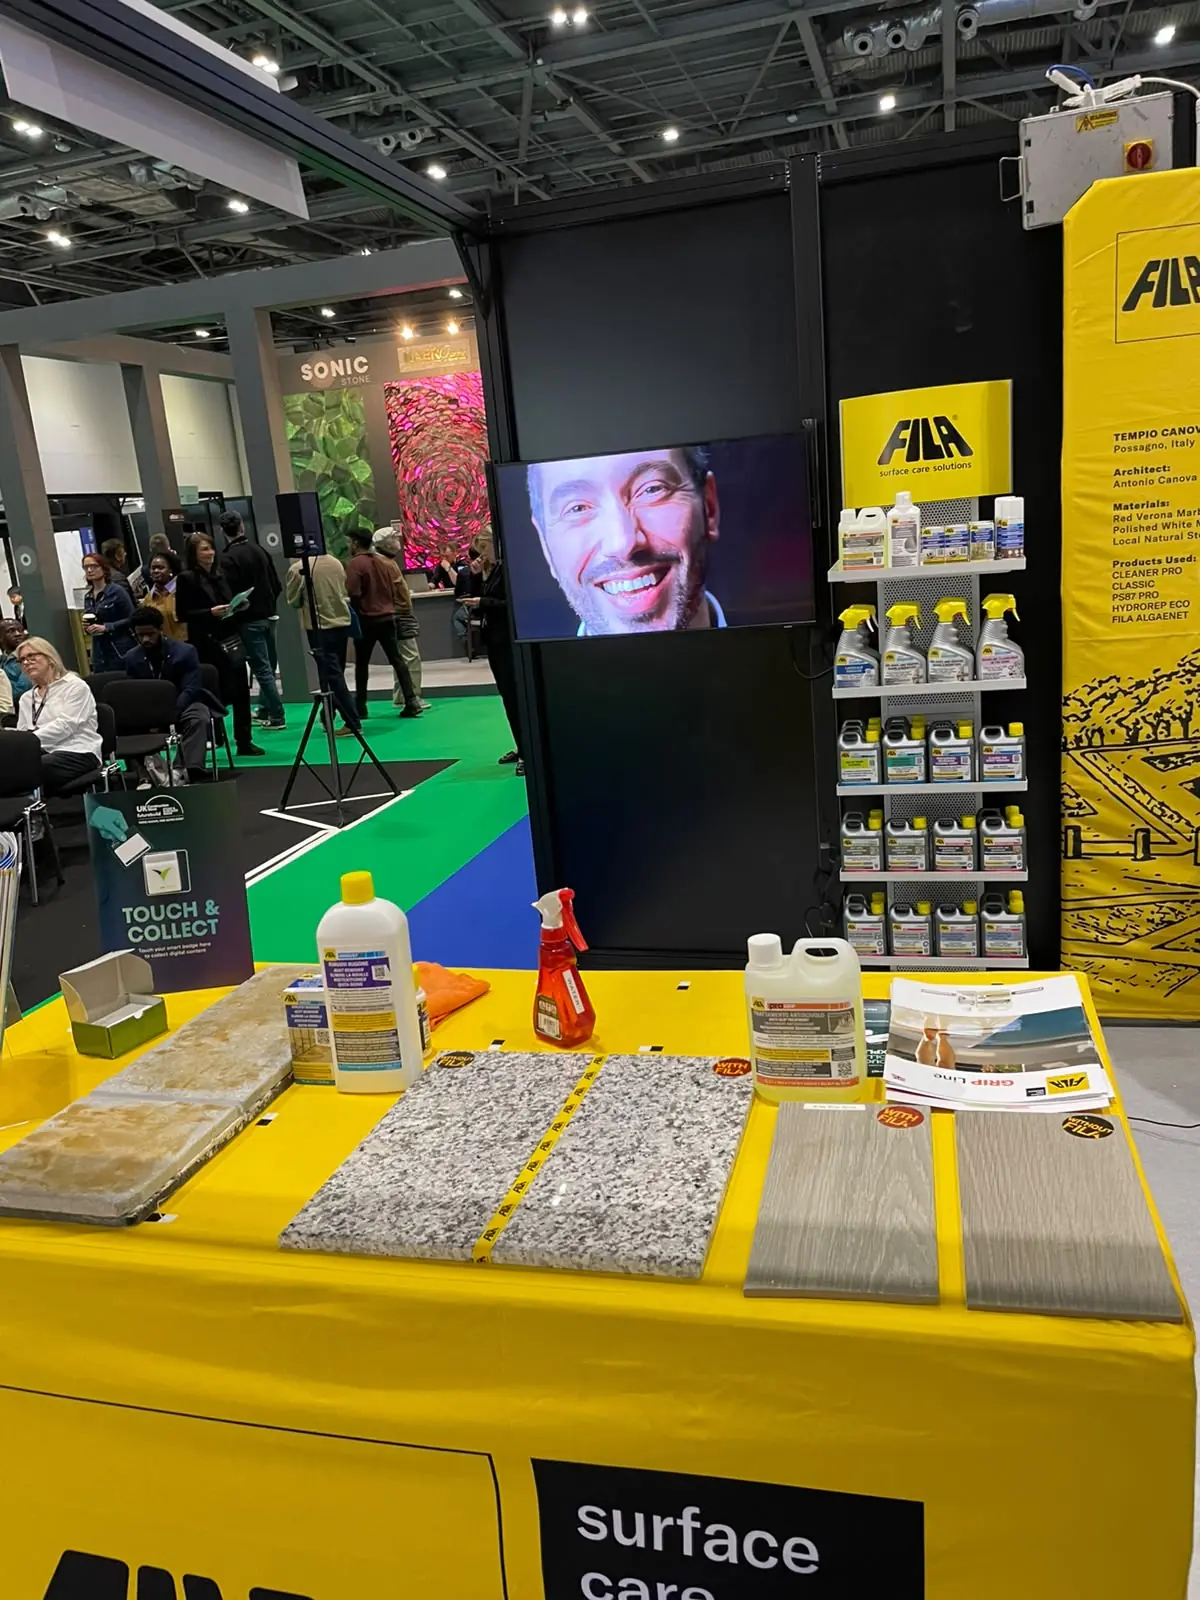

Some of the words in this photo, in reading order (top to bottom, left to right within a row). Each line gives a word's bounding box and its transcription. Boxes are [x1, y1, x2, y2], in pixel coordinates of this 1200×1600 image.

[301, 356, 369, 381] SONIC
[341, 375, 371, 386] STONE
[877, 415, 974, 466] FILA
[1113, 430, 1158, 441] TEMPIO
[1113, 442, 1168, 454] Possagno,
[1171, 438, 1195, 449] Italy
[879, 468, 909, 477] surface
[912, 465, 930, 474] care
[933, 462, 972, 472] solutions
[1113, 465, 1171, 477] Architect:
[1113, 477, 1155, 488] Antonio
[1158, 474, 1198, 484] Canova
[1113, 499, 1170, 511] Materials:
[1113, 513, 1133, 523] Red
[1136, 511, 1173, 521] Verona
[1113, 523, 1158, 534] Polished
[1161, 520, 1193, 530] White
[1113, 535, 1141, 546] Local
[1144, 532, 1184, 543] Natural
[1187, 531, 1200, 540] St
[1112, 557, 1162, 568] Products
[1165, 554, 1197, 564] Used:
[1112, 568, 1159, 580] CLEANER
[1161, 566, 1183, 576] PRO
[1112, 580, 1155, 591] CLASSIC
[1112, 592, 1136, 602] PS87
[1138, 590, 1160, 600] PRO
[1112, 601, 1167, 613] HYDROREP
[1169, 599, 1191, 609] ECO
[1112, 614, 1134, 624] FILA
[1136, 610, 1189, 622] ALGAENET
[122, 901, 198, 924] TOUCH
[205, 899, 220, 916] &
[127, 919, 219, 943] COLLECT
[715, 1067, 745, 1075] FILA
[933, 1073, 966, 1084] Line
[970, 1079, 1014, 1087] GRIP
[1049, 1075, 1086, 1090] FILA
[878, 1114, 908, 1127] FILA
[883, 1108, 919, 1122] WITH
[1062, 1121, 1099, 1139] FILA
[1066, 1116, 1113, 1134] WITHOUT
[576, 1504, 820, 1575] surface
